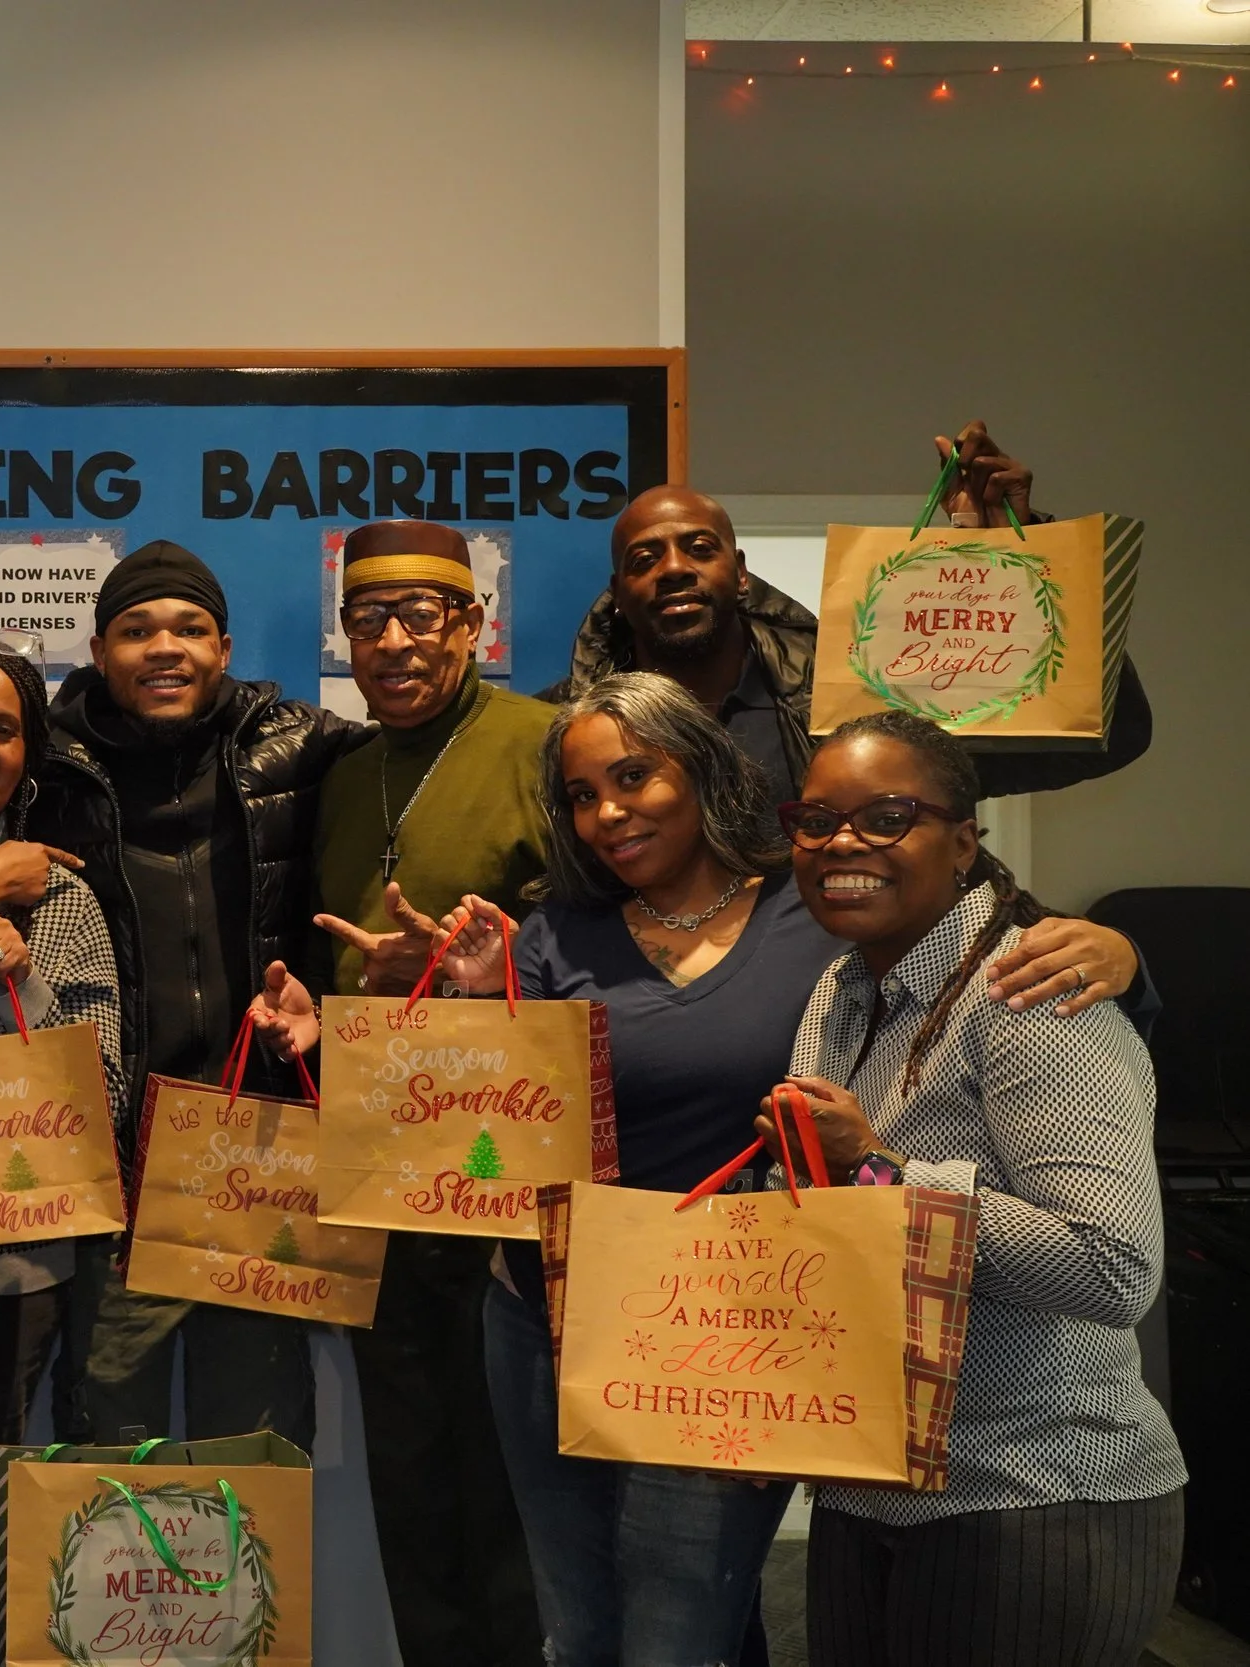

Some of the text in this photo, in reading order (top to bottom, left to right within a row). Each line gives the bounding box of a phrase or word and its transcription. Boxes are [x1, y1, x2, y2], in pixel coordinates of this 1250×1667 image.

[202, 449, 629, 520] BARRIERS
[2, 569, 43, 580] NOW
[49, 569, 96, 580] HAVE
[938, 567, 990, 584] MAY
[22, 592, 101, 604] DRIVER'S
[904, 584, 1023, 607] your days be
[903, 608, 1017, 637] MERRY
[942, 637, 976, 649] AND
[885, 641, 1030, 691] Bright
[386, 1009, 428, 1030] the
[374, 1037, 508, 1083] Season
[359, 1073, 565, 1124] to Sparkle
[216, 1106, 253, 1128] the
[195, 1131, 318, 1175] Season
[398, 1160, 421, 1182] &
[180, 1175, 207, 1196] to
[404, 1170, 538, 1220] Shine
[205, 1243, 225, 1264] &
[693, 1239, 773, 1260] HAVE
[210, 1256, 331, 1305] Shine
[621, 1249, 825, 1318] yourself
[670, 1306, 794, 1331] A MERRY
[603, 1381, 858, 1425] CHRISTMAS
[103, 1545, 152, 1565] your
[203, 1539, 226, 1558] be
[105, 1569, 225, 1603] MERRY
[148, 1603, 183, 1616] AND
[90, 1608, 239, 1667] Bright
